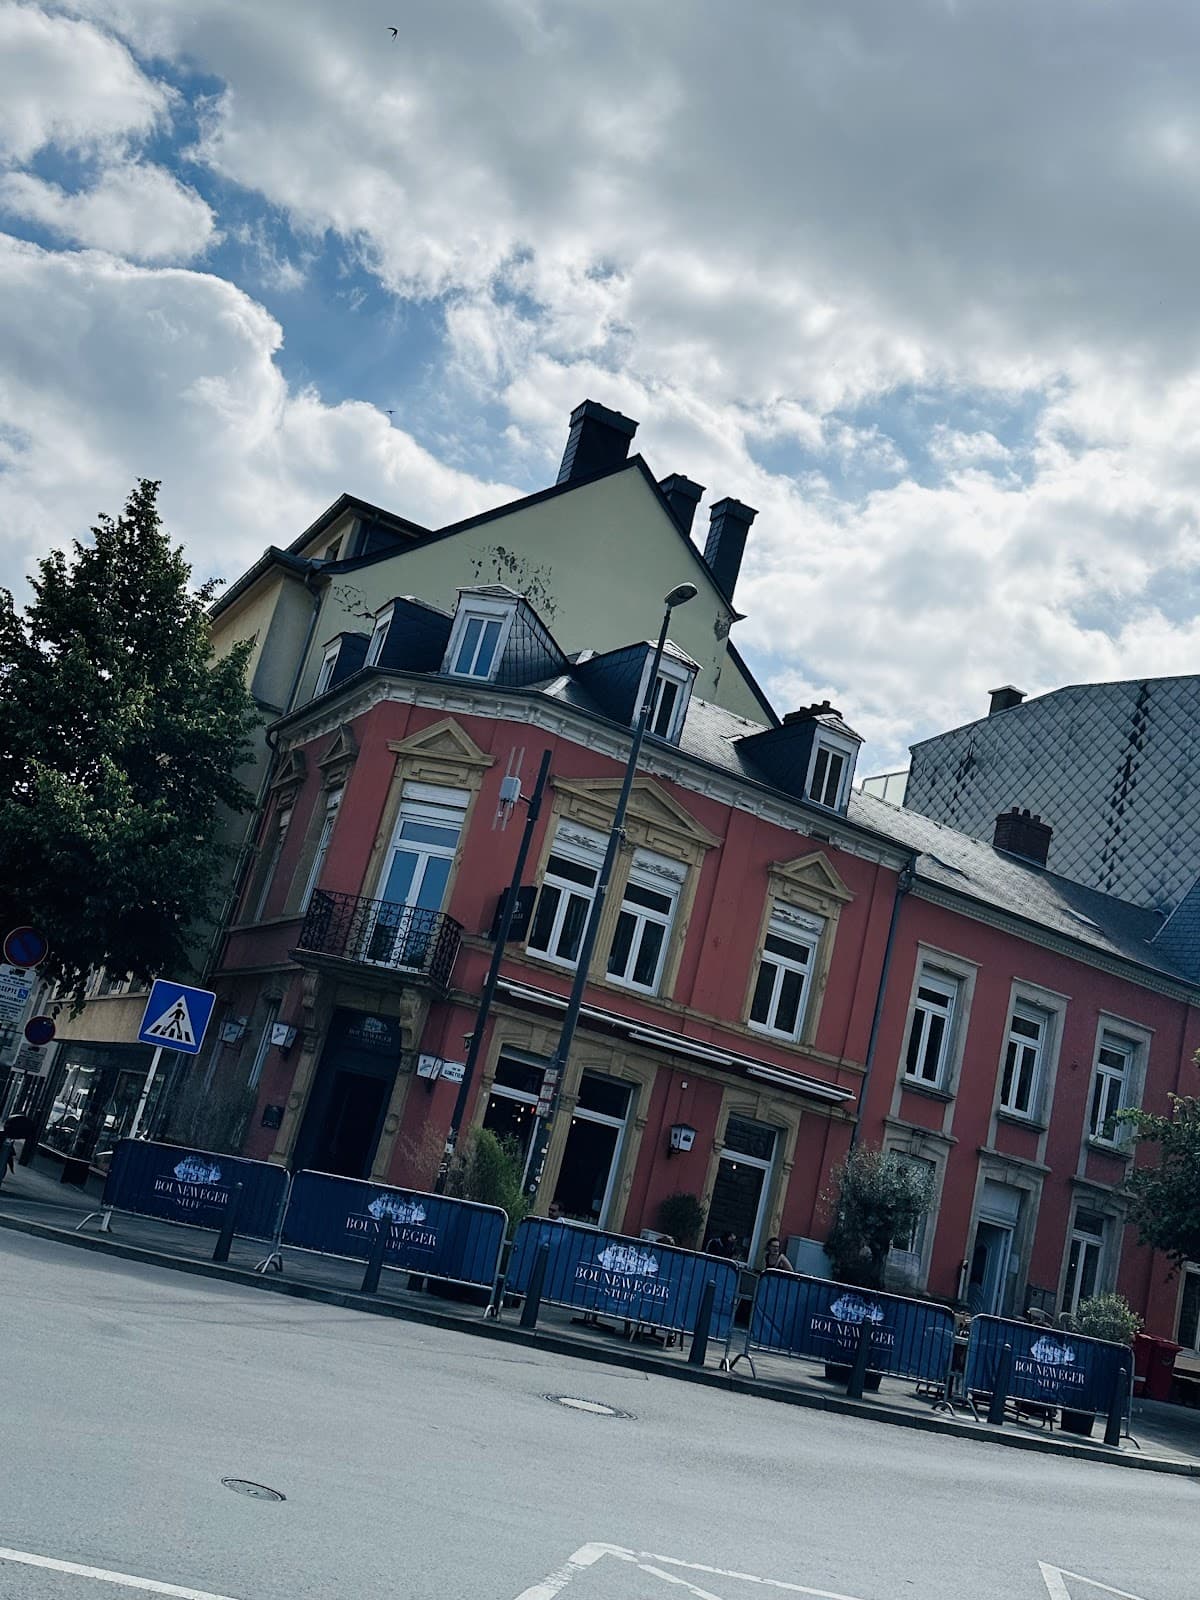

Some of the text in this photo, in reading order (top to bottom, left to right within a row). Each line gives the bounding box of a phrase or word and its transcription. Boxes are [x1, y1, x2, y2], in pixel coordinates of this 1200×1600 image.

[346, 1217, 437, 1247] BOUNWEGER
[575, 1266, 670, 1299] BOUNEWEGER
[603, 1287, 637, 1302] STUFF
[811, 1318, 895, 1346] BOUNEWGER
[1015, 1360, 1085, 1385] BOUNEWEGER
